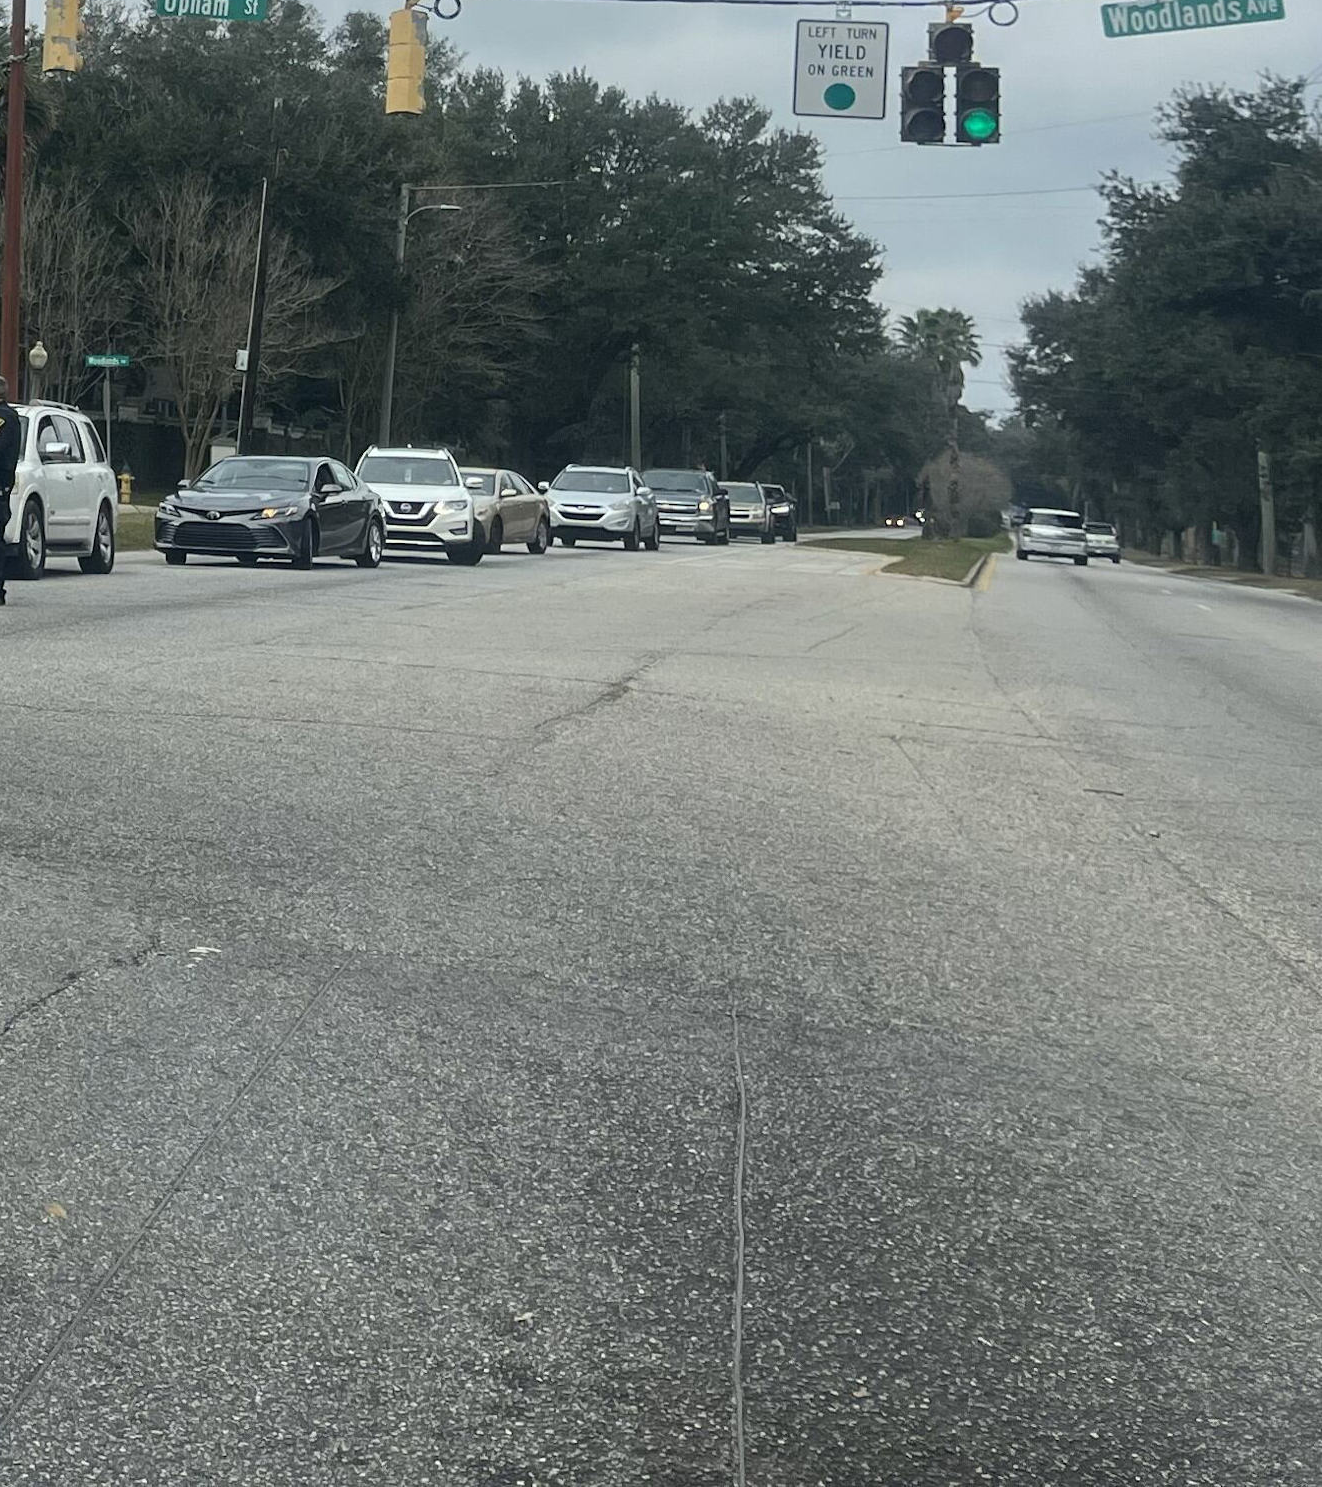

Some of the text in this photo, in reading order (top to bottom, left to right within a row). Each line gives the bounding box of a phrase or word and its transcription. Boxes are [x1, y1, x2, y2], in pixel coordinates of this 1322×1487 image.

[808, 26, 877, 40] LEFT TURN
[818, 43, 866, 60] YIELD
[807, 64, 874, 78] ON GREEN
